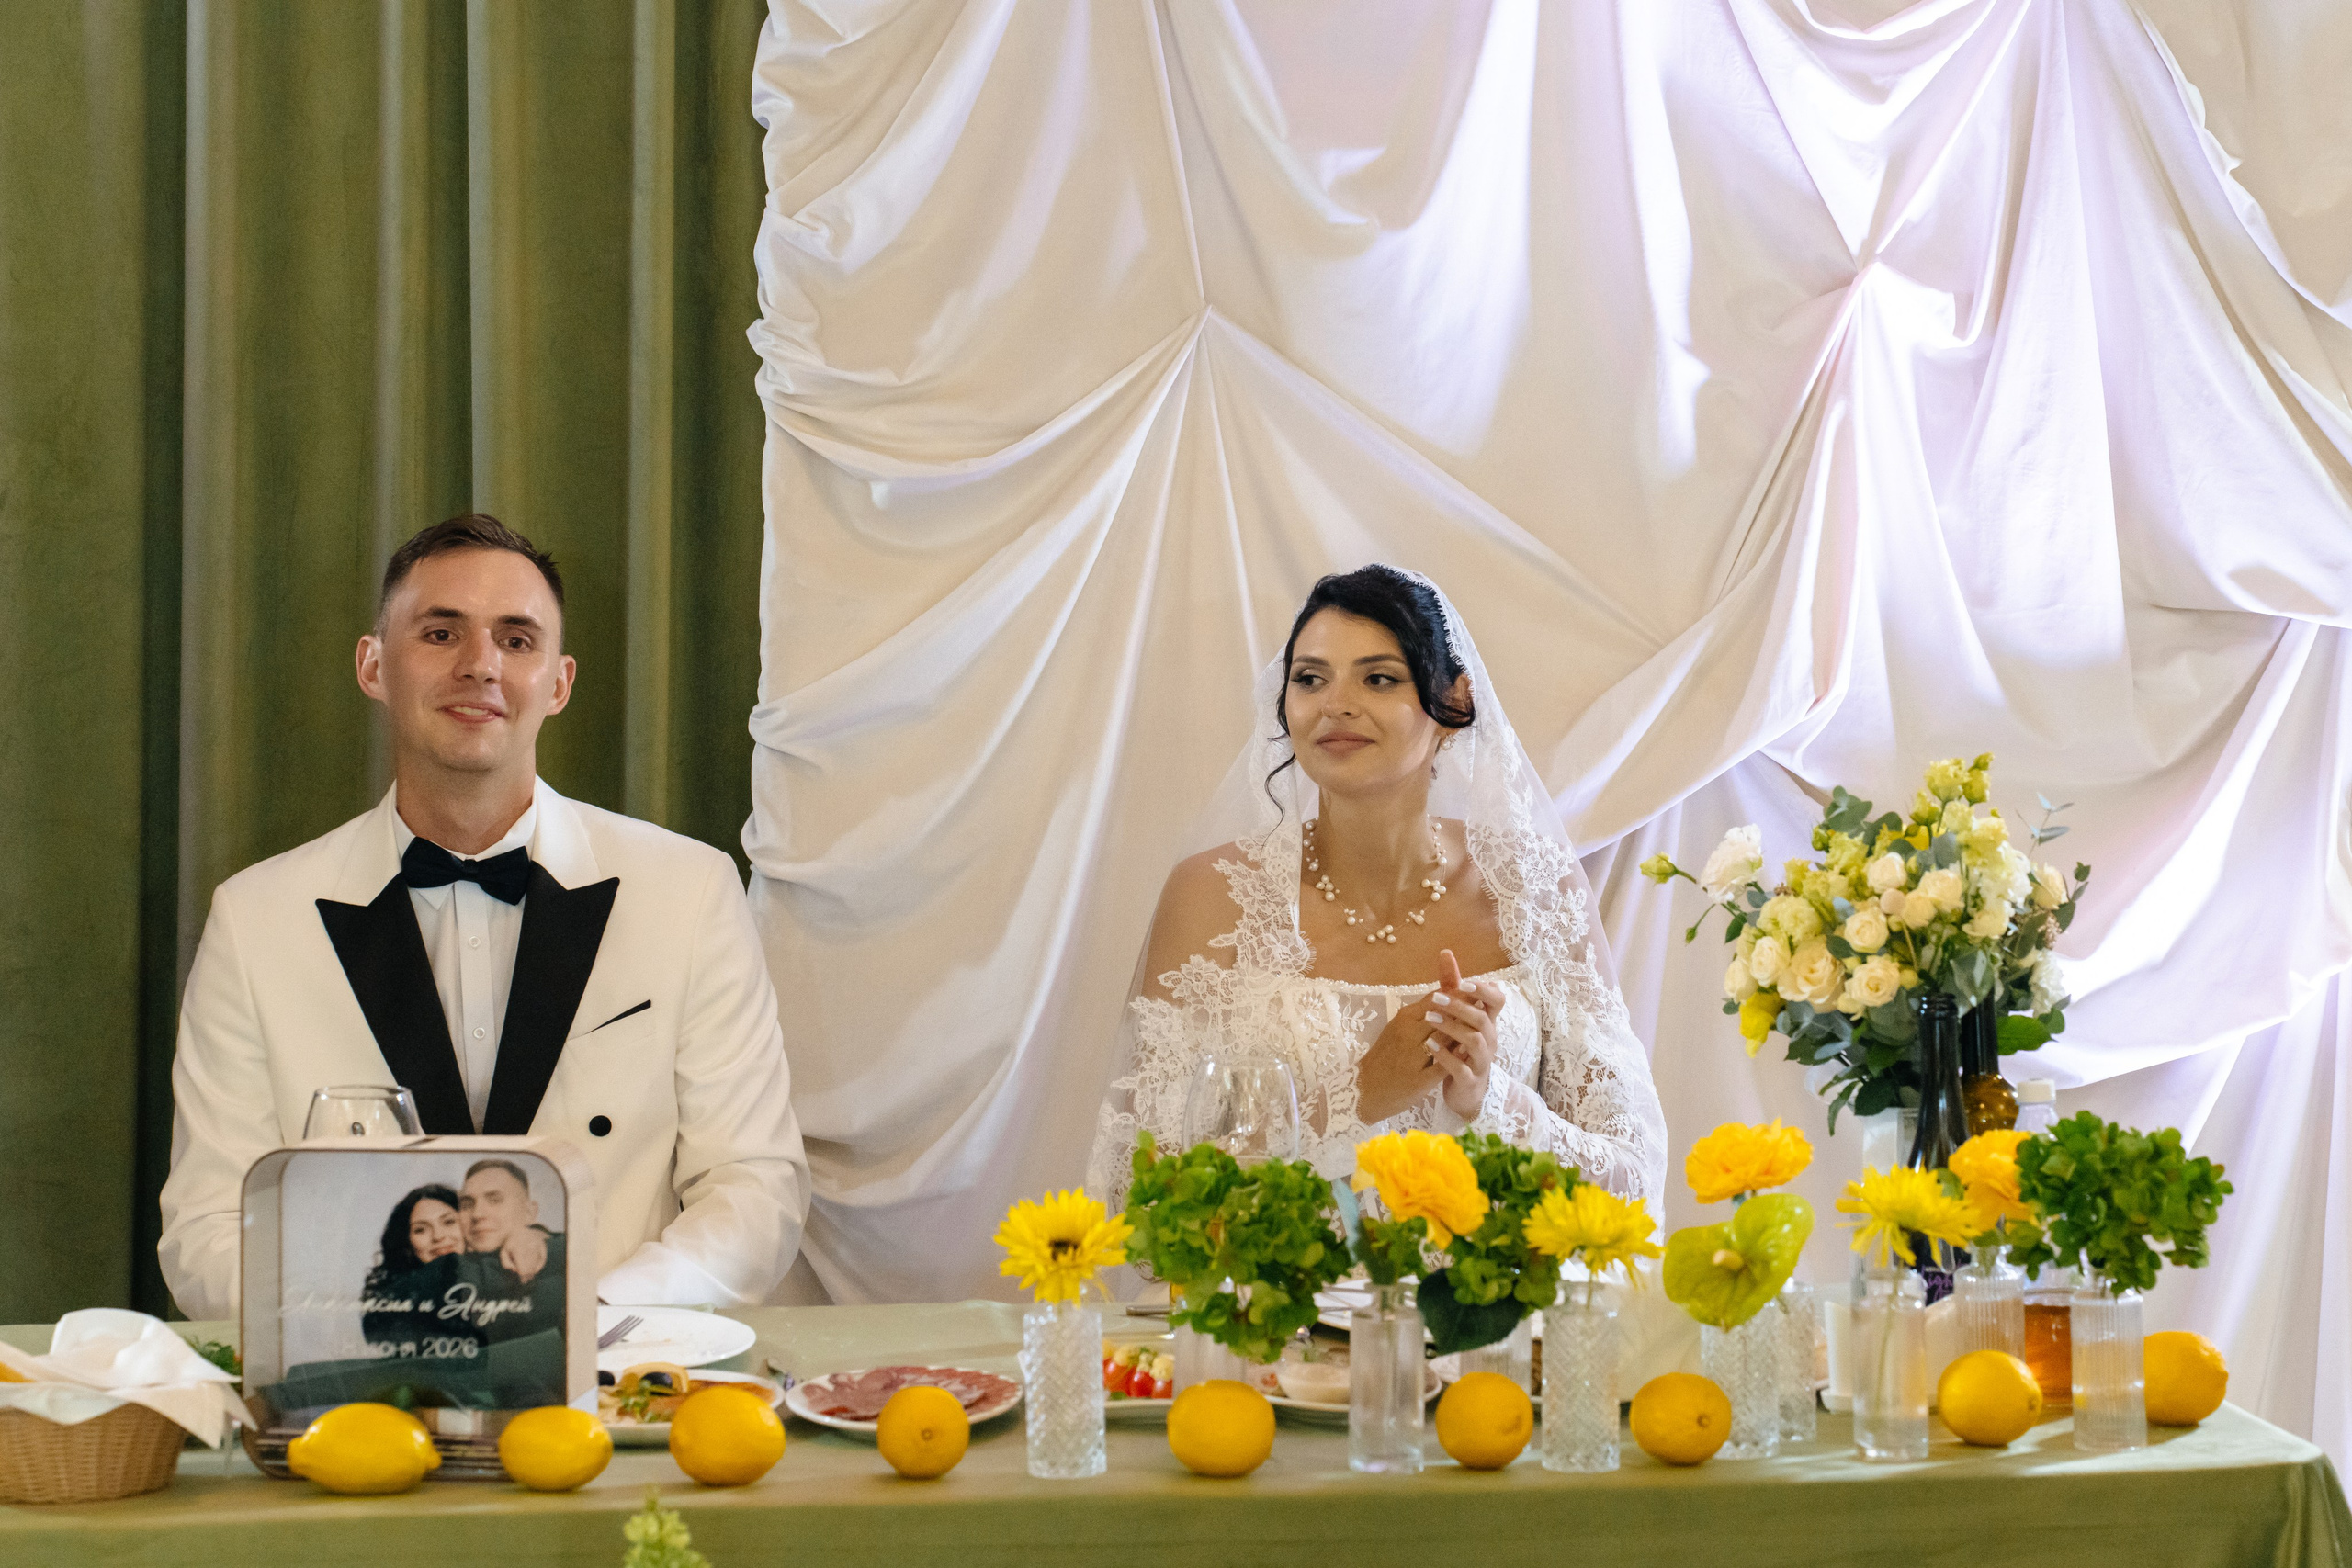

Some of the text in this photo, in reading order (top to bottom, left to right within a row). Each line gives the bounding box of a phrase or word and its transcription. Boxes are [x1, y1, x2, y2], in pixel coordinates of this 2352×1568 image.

[418, 1298, 435, 1313] и
[437, 1283, 533, 1327] Андрей
[422, 1337, 479, 1359] 2026
